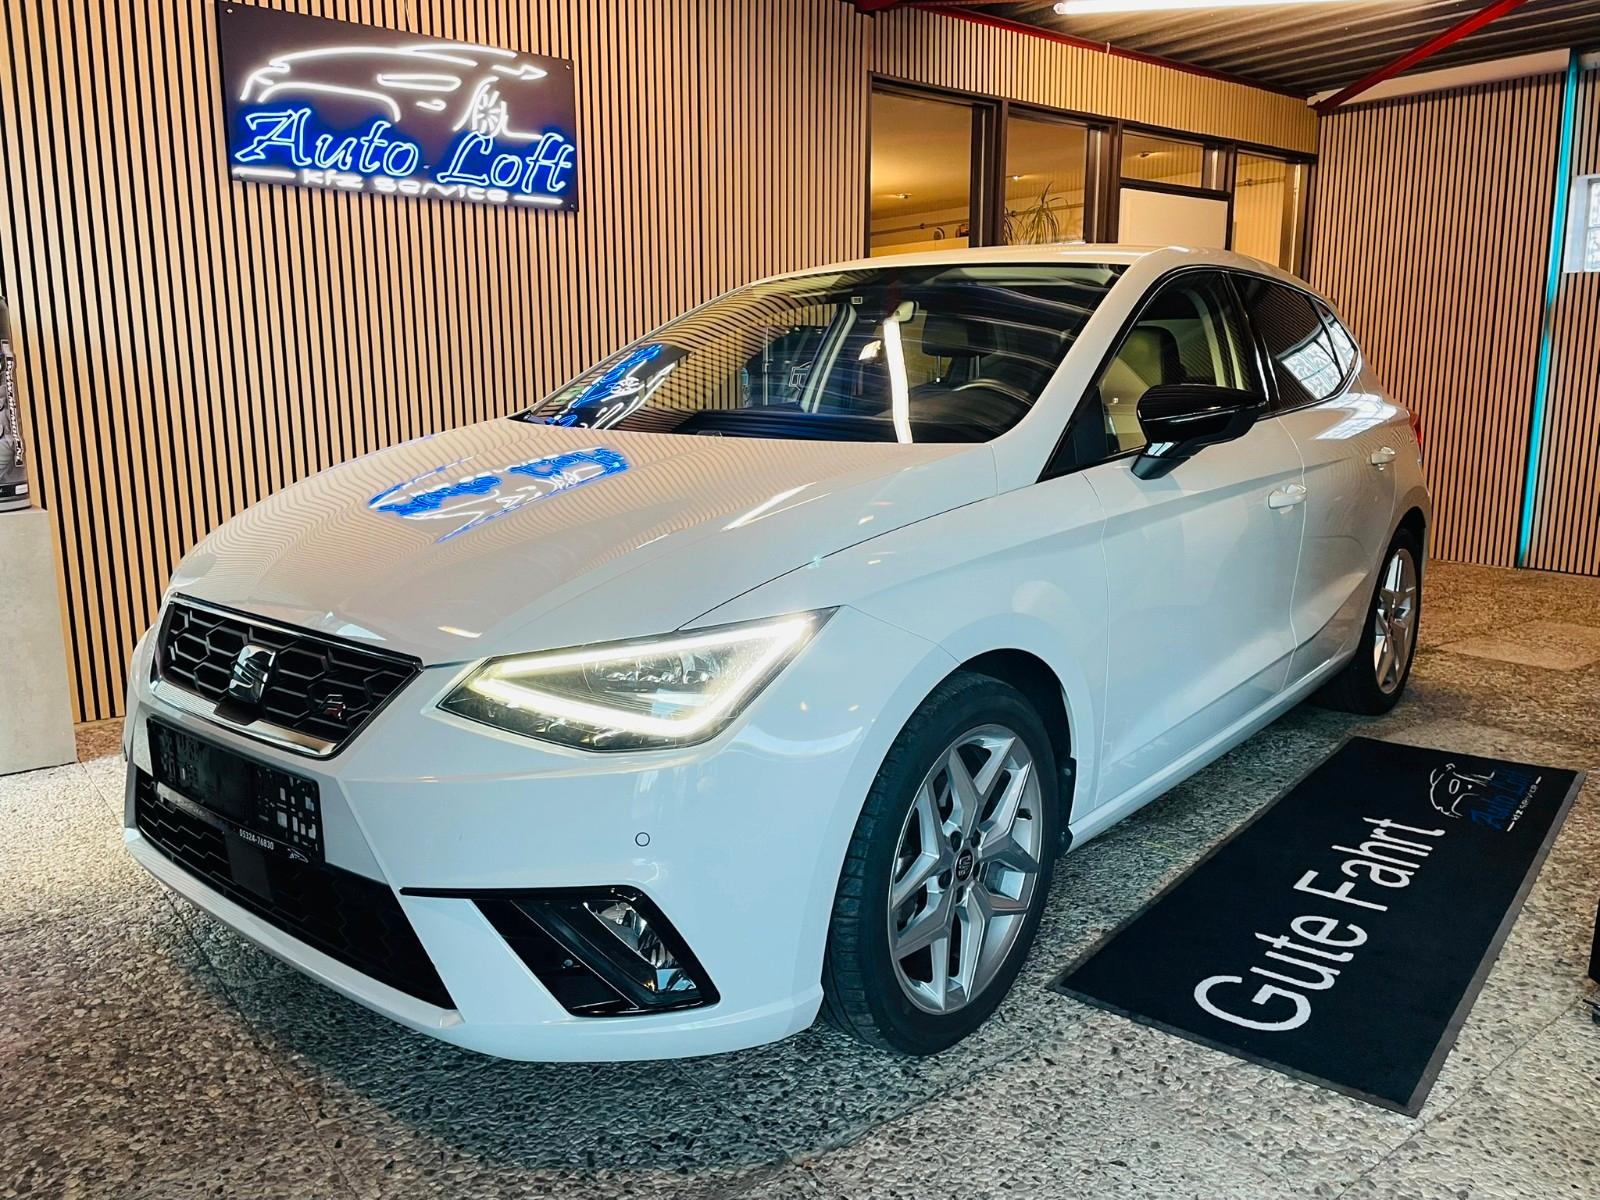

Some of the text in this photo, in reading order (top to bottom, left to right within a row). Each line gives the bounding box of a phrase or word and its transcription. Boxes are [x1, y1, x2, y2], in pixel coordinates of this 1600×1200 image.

[235, 108, 574, 193] Auto Loft
[1194, 817, 1446, 1031] Gute Fahrt
